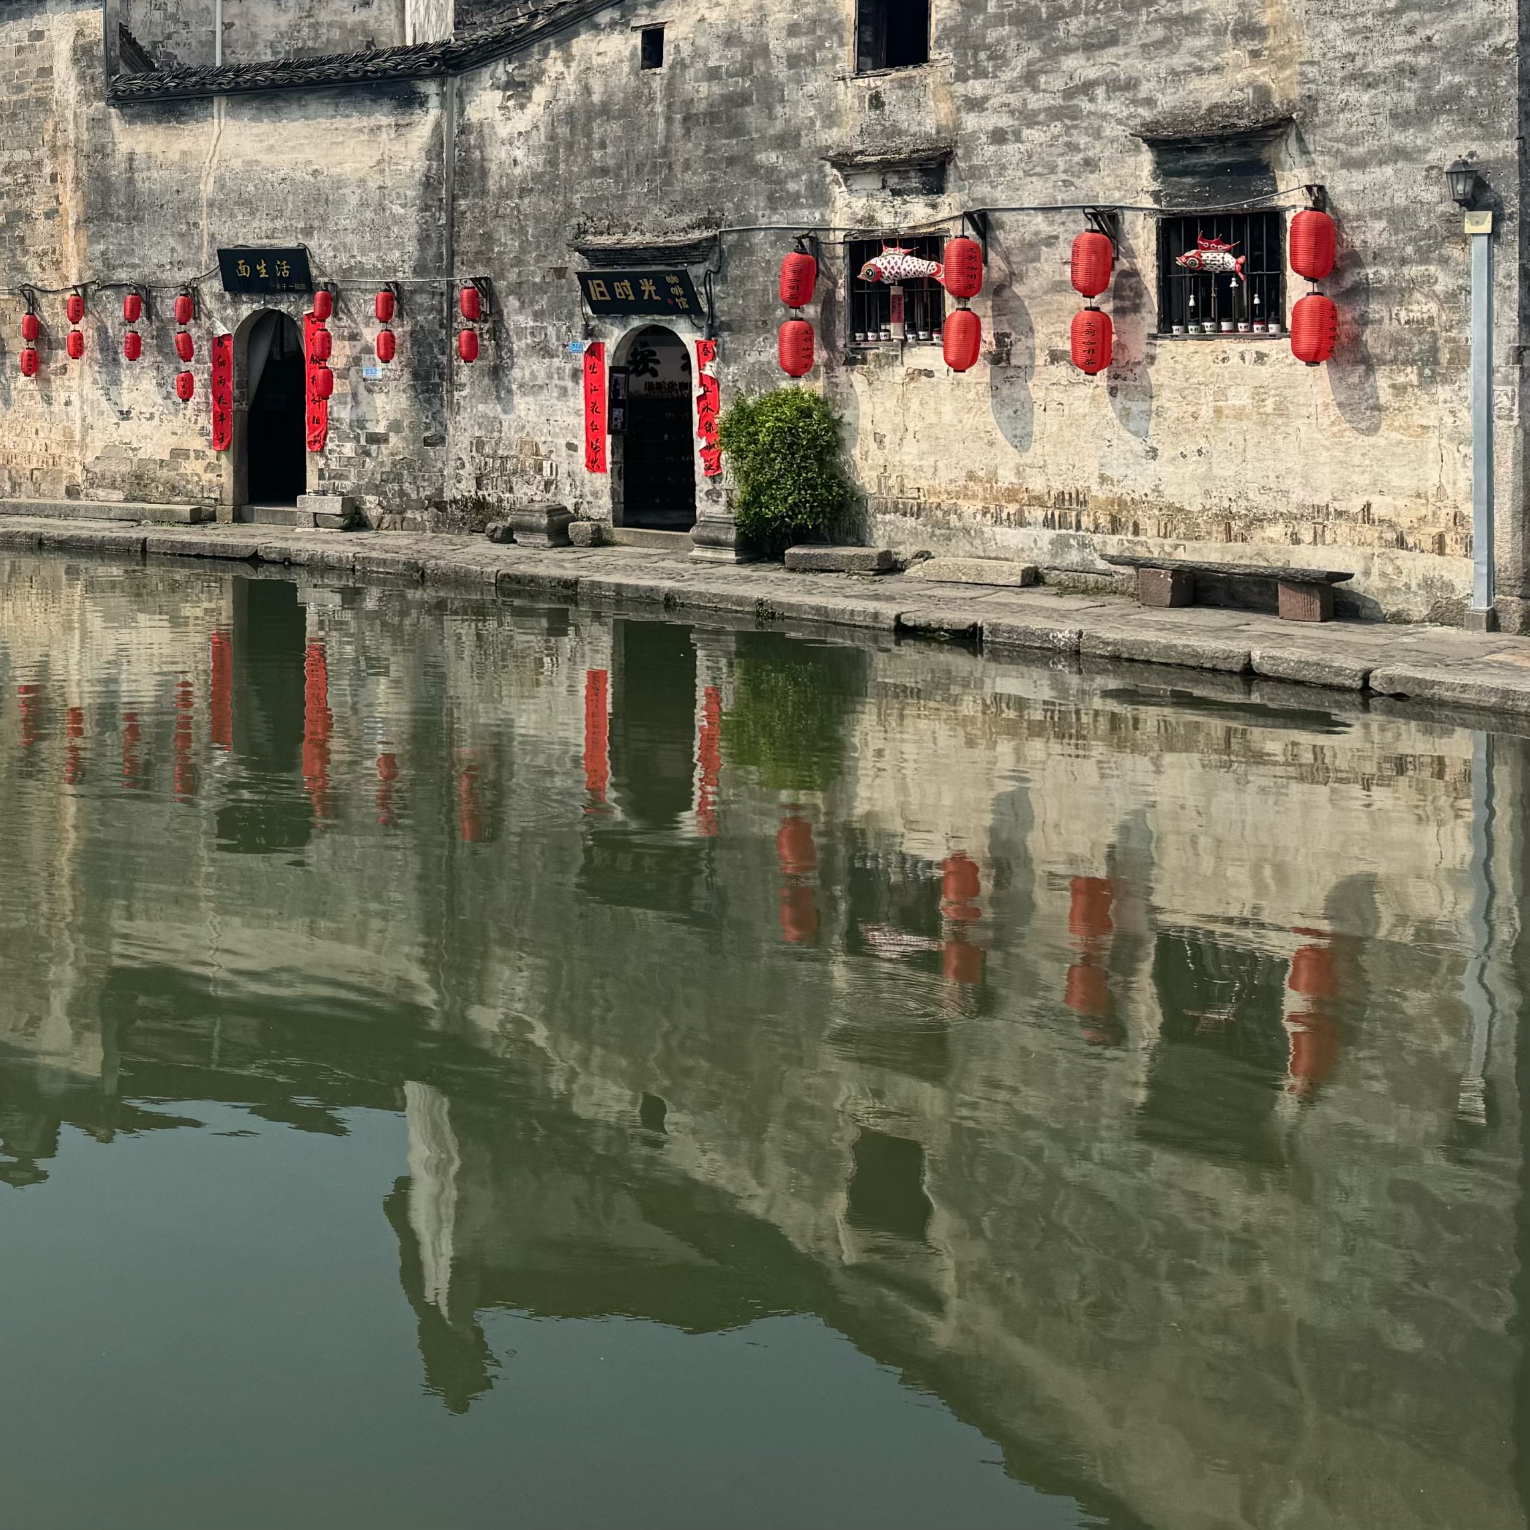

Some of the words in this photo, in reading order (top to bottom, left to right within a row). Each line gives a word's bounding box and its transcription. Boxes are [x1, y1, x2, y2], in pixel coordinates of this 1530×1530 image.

[236, 258, 291, 279] 面生活
[587, 277, 663, 301] 旧时光
